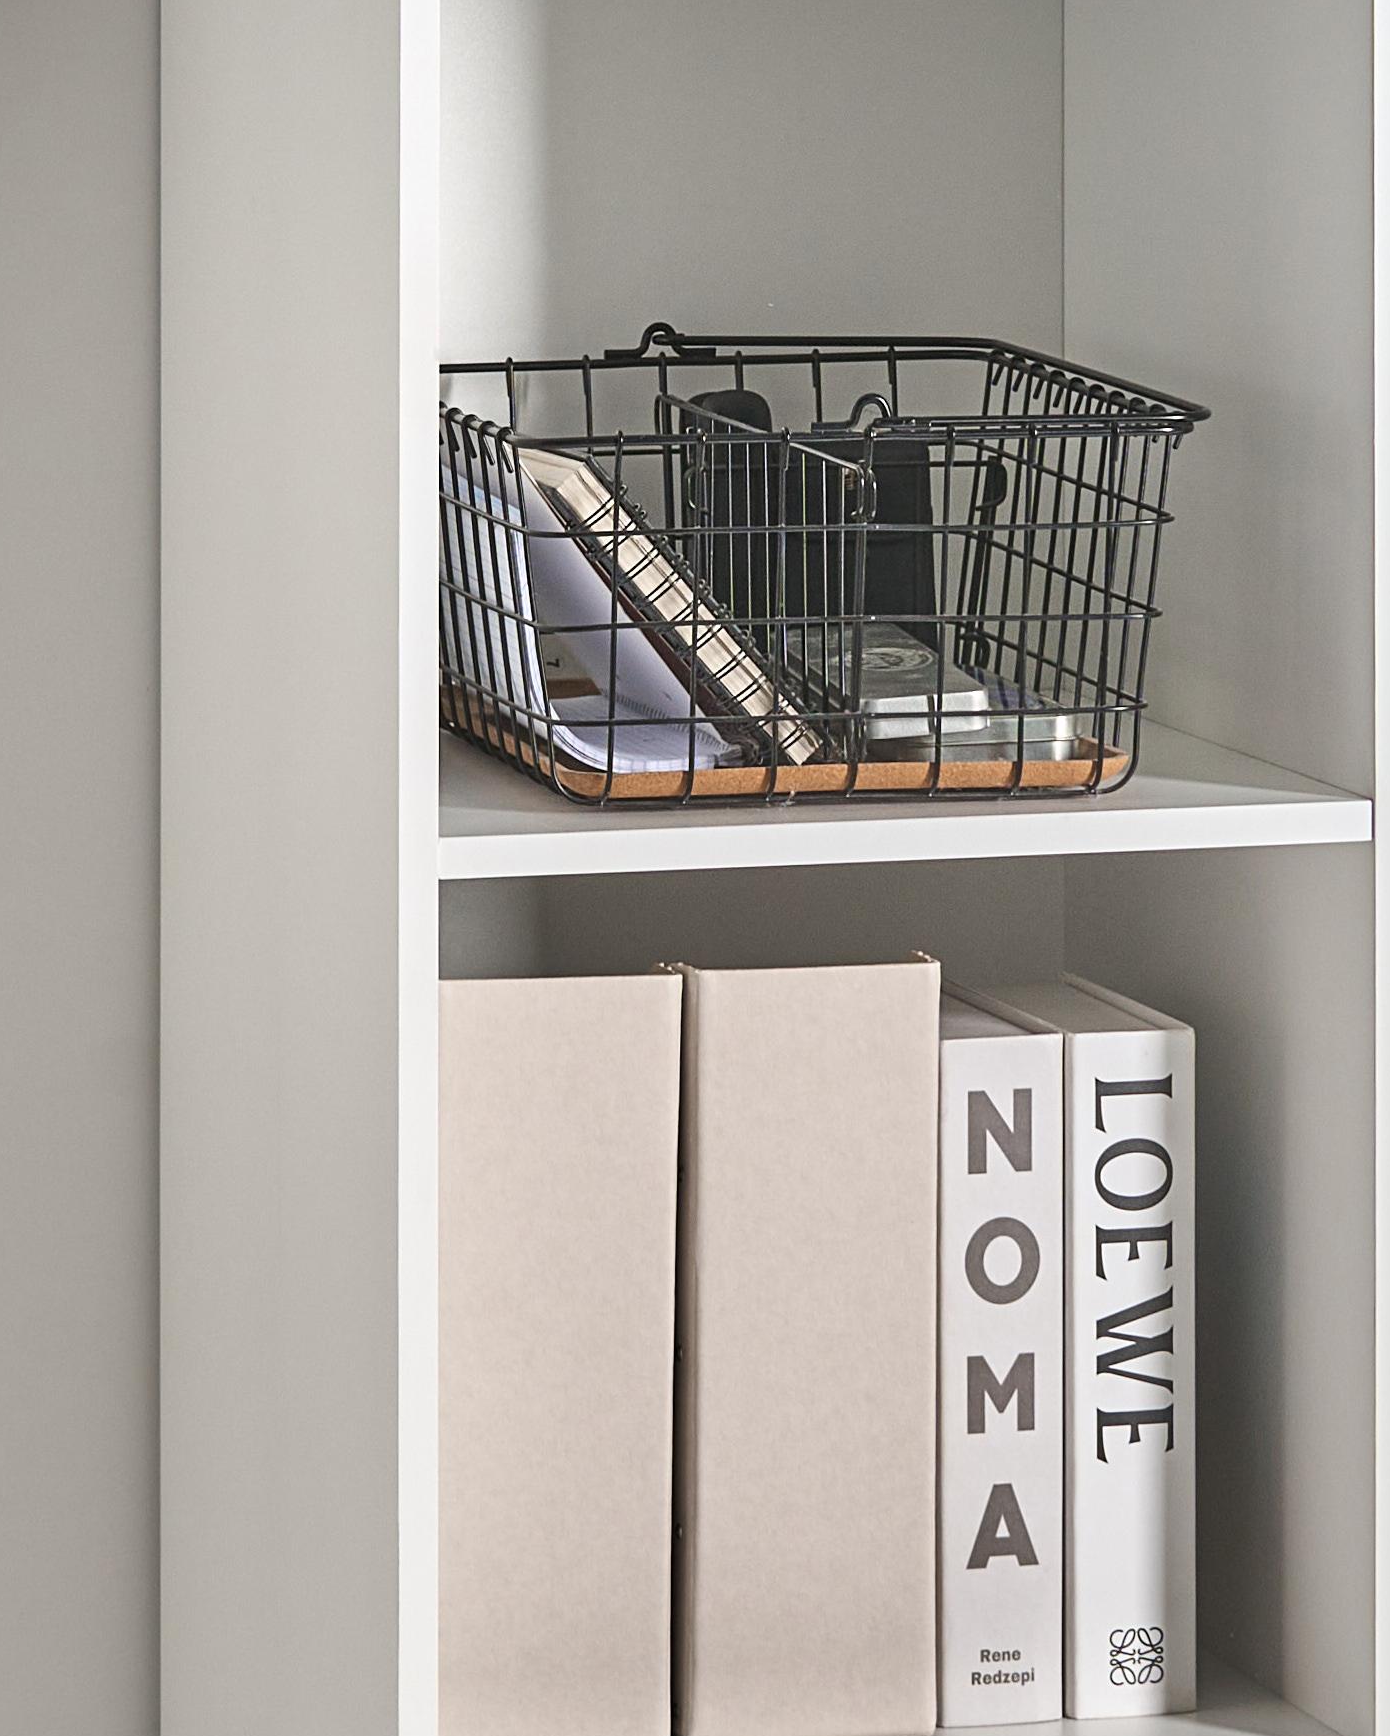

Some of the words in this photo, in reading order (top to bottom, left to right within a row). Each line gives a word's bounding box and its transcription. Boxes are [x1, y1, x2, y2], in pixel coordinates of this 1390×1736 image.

[965, 1088, 1040, 1570] NOMA
[1095, 1072, 1173, 1464] LOEWE
[971, 1668, 1035, 1686] Redzepi
[980, 1648, 1021, 1663] Rene
